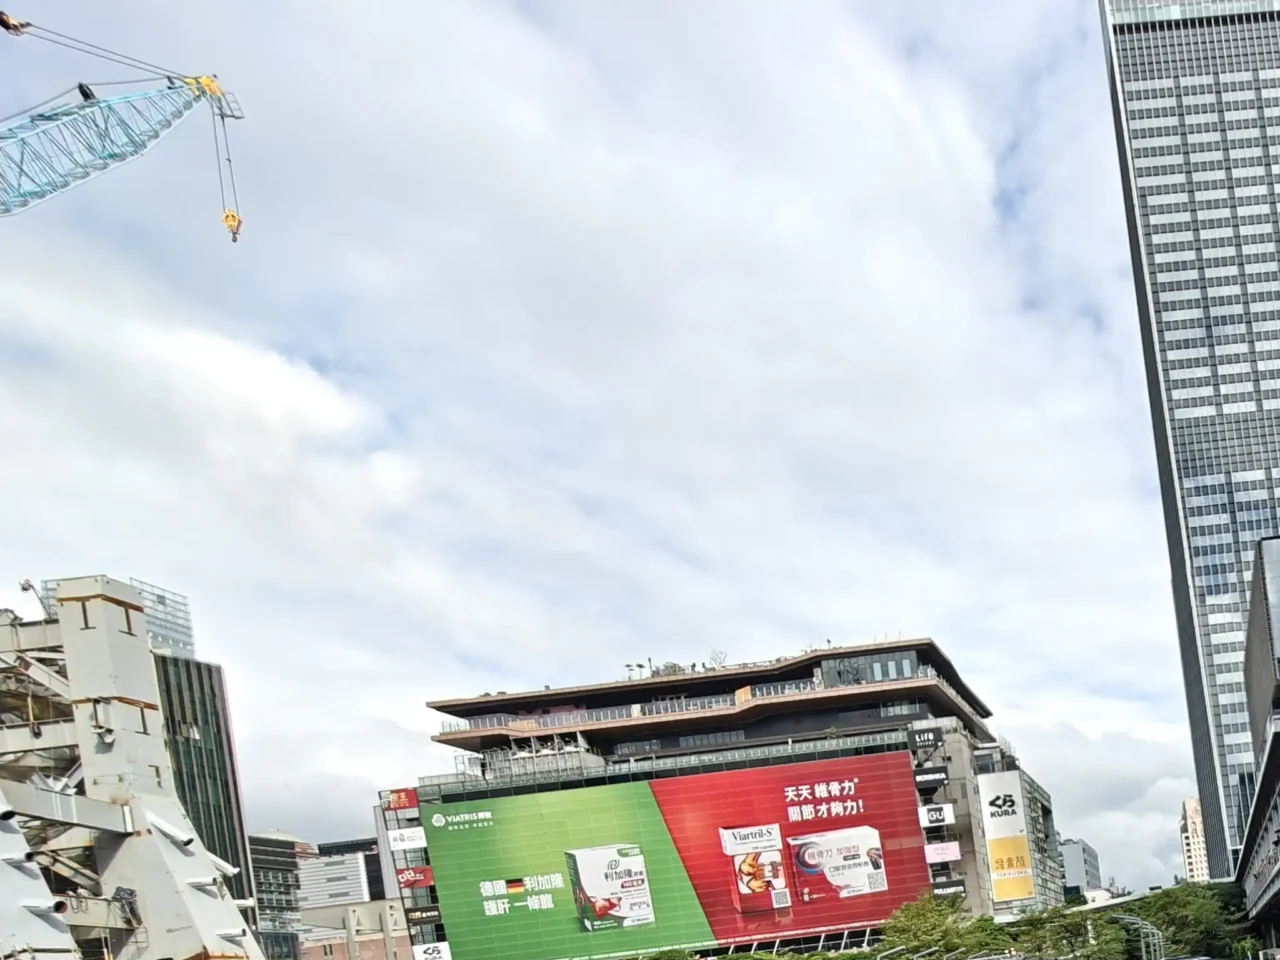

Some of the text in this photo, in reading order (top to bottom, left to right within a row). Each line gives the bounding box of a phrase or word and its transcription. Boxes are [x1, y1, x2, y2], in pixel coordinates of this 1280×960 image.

[784, 780, 856, 802] 天天 維骨力
[988, 794, 1016, 810] くら
[445, 812, 478, 823] VIATRIS
[928, 811, 944, 820] GU
[990, 809, 1018, 818] KURA
